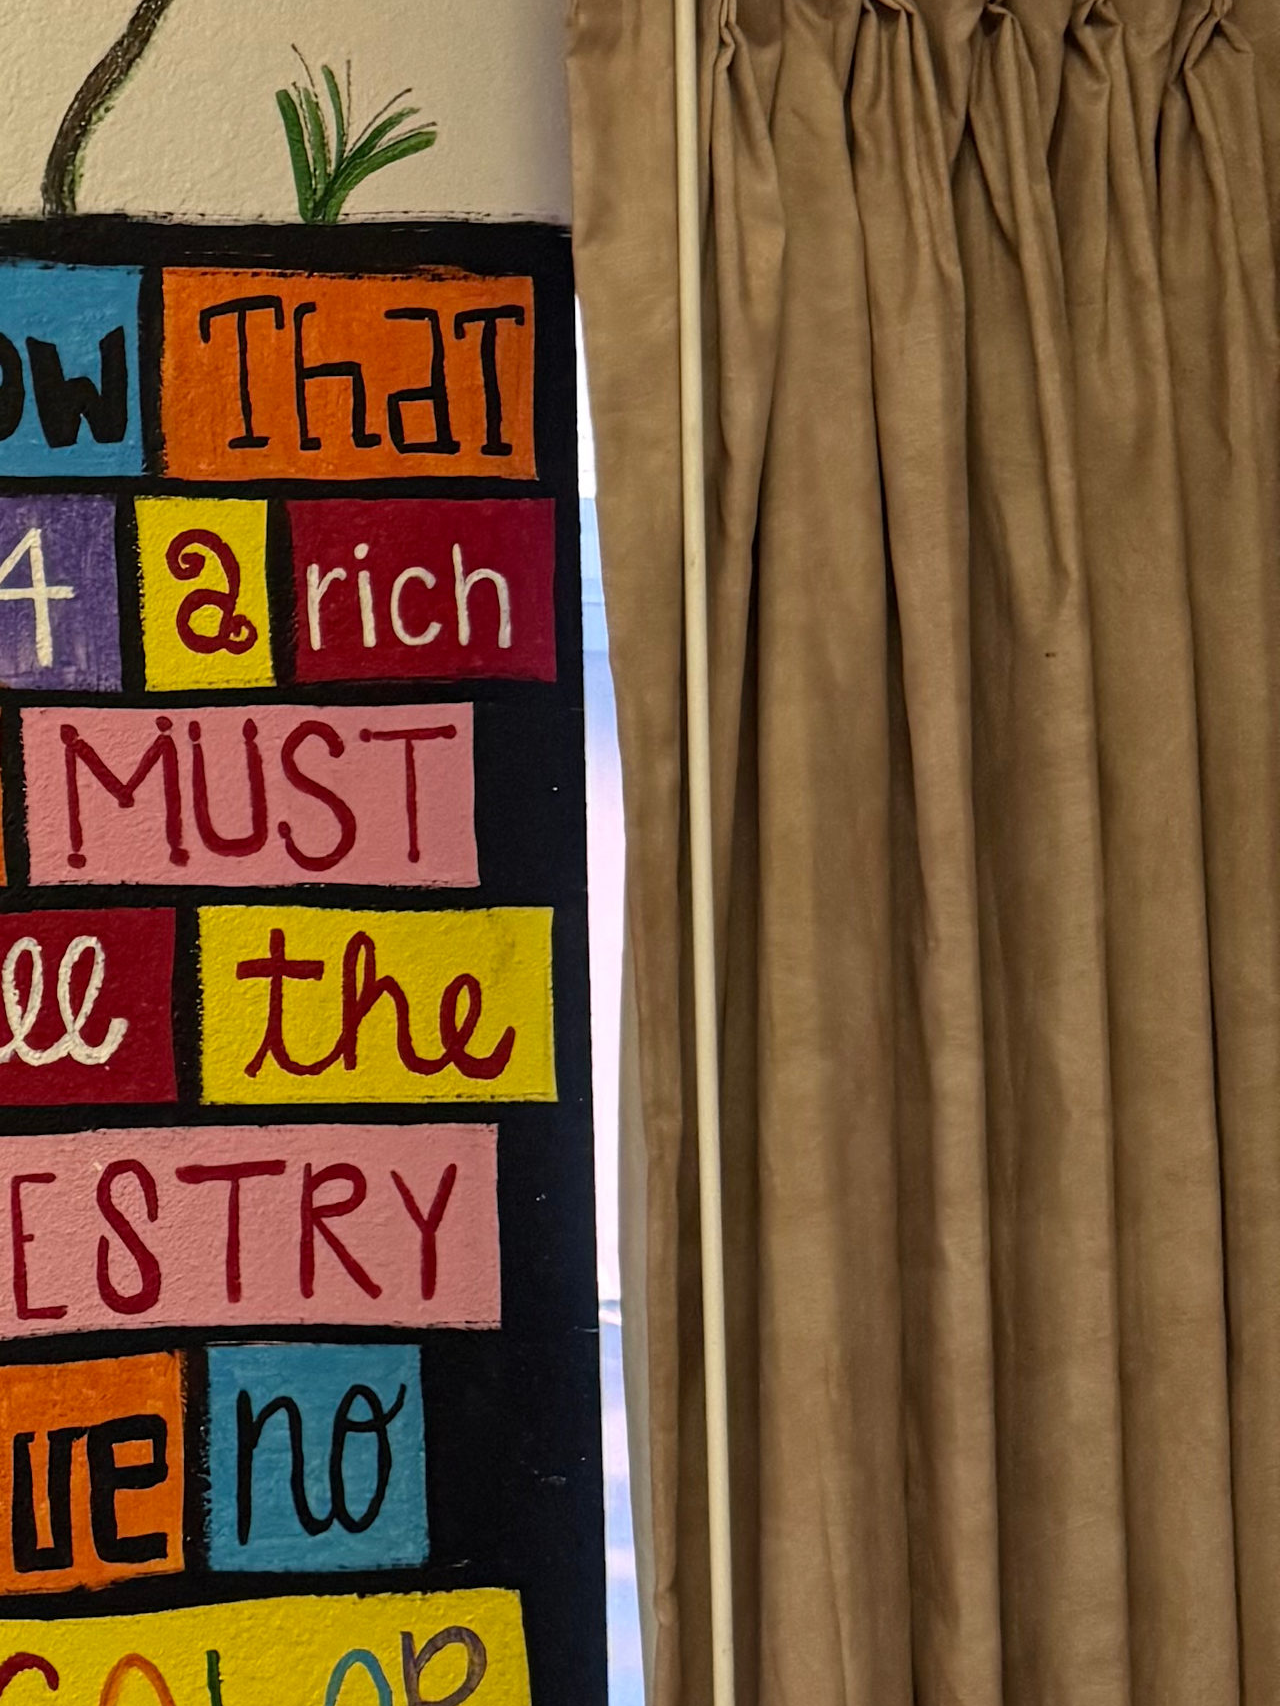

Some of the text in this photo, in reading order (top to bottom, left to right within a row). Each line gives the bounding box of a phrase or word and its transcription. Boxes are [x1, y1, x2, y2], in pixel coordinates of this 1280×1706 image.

[166, 527, 259, 656] a
[305, 541, 515, 654] rich
[57, 714, 459, 873] MUST
[236, 926, 519, 1082] the
[236, 1382, 408, 1549] no
